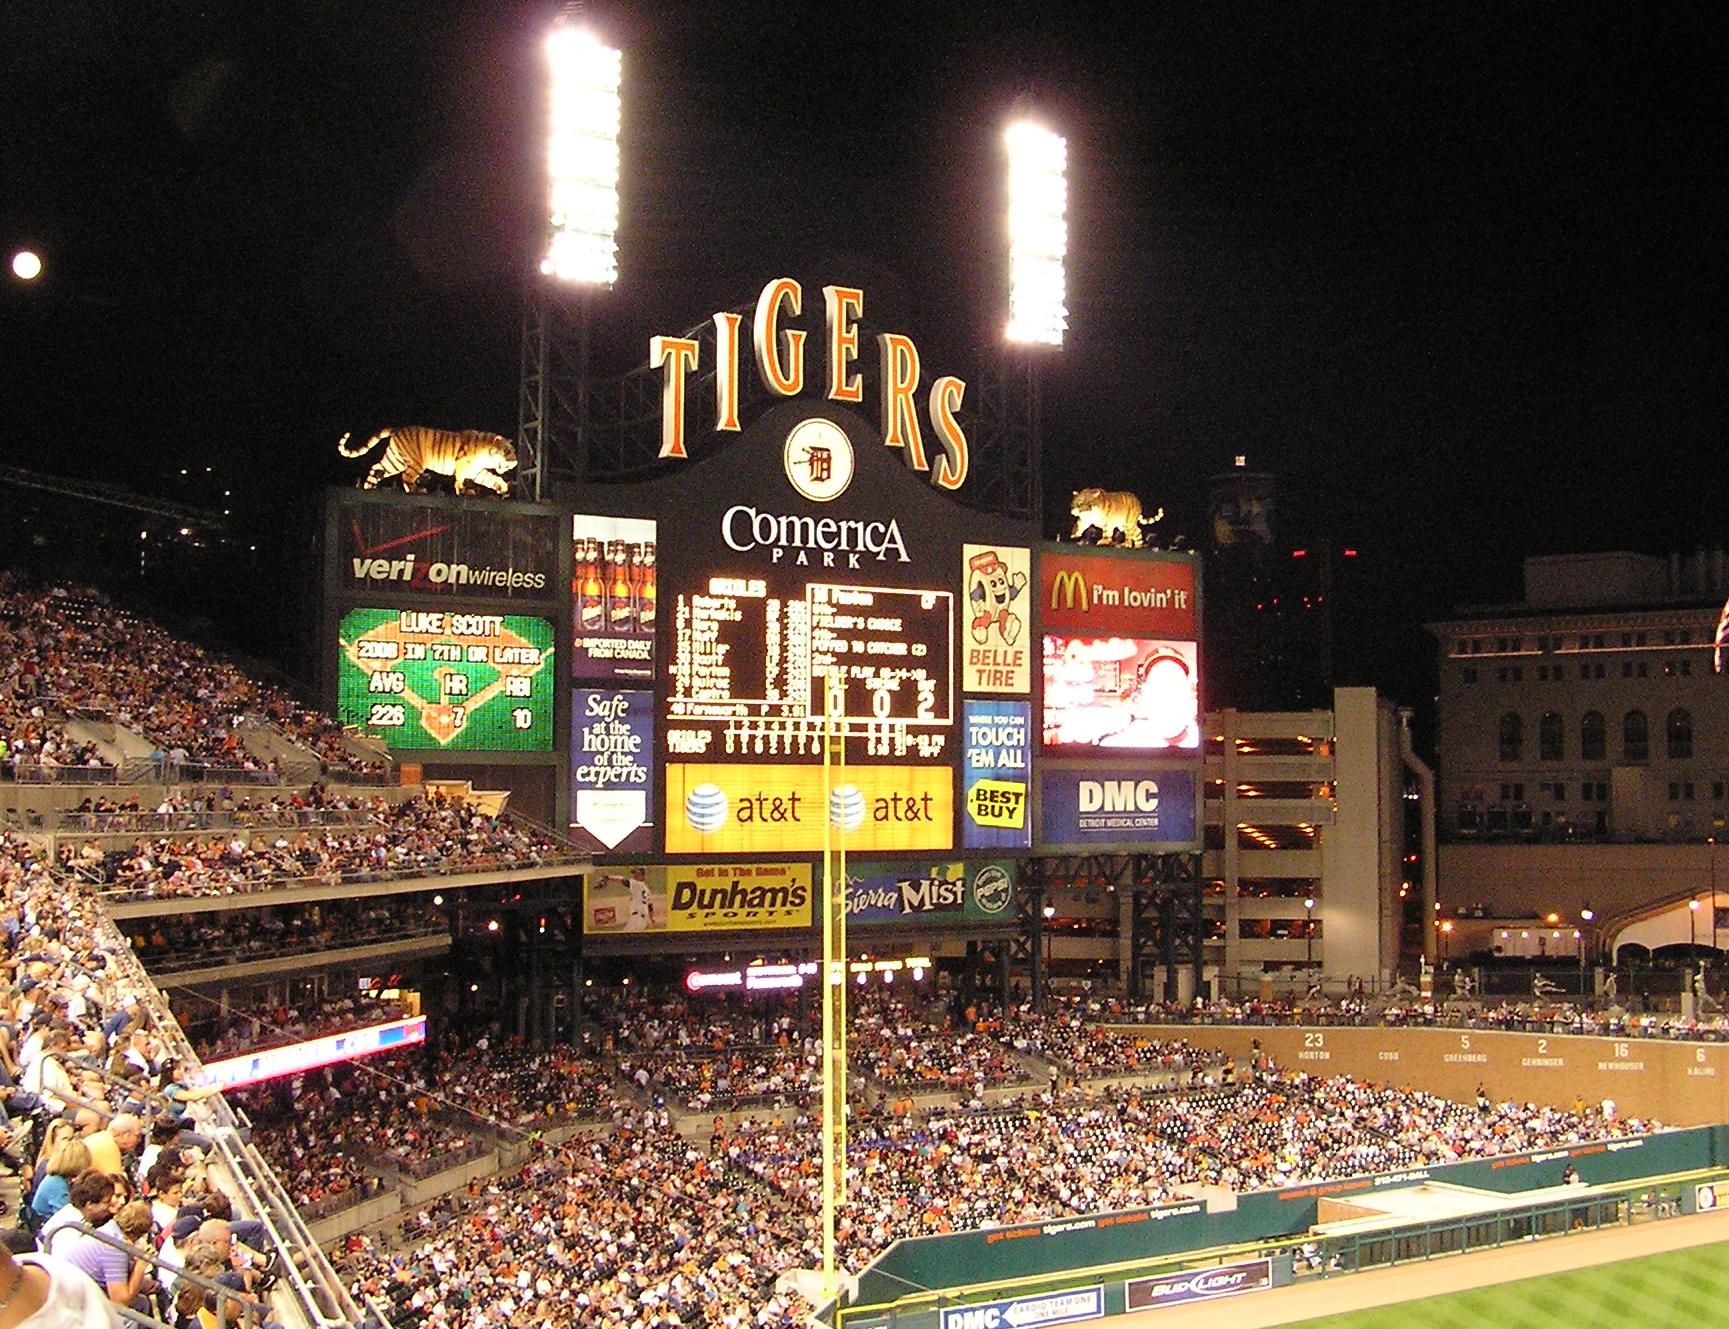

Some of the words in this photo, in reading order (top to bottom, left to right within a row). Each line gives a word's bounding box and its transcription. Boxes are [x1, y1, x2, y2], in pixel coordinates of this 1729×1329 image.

[650, 277, 970, 490] TIGERS
[772, 548, 861, 569] PARK
[353, 554, 468, 588] verizon
[469, 567, 546, 588] wireless
[1093, 584, 1119, 606] i'm
[1124, 586, 1171, 608] lovin'
[1174, 589, 1188, 609] it
[401, 612, 444, 634] LUKE
[450, 615, 504, 637] SCOTT
[404, 642, 426, 660] IN
[432, 643, 461, 661] 7TH
[467, 645, 488, 662] OR
[493, 646, 541, 664] LATER
[582, 637, 627, 649] IMPORTED
[627, 639, 652, 651] DAILY
[588, 648, 614, 658] FROM
[969, 649, 1023, 667] BELLE
[369, 671, 405, 693] AVG
[444, 673, 468, 695] HR
[505, 676, 531, 697] RBI
[976, 669, 1015, 687] TIRE
[585, 694, 629, 722] Safe
[873, 688, 891, 718] 0
[917, 690, 935, 719] 2
[368, 704, 405, 726] .226
[452, 706, 465, 728] 7
[512, 708, 532, 729] 10
[994, 716, 1008, 725] YOU
[1009, 716, 1024, 725] CAN
[592, 721, 608, 735] at
[609, 720, 631, 735] the
[969, 727, 1025, 747] TOUCH
[582, 728, 641, 752] home
[594, 751, 611, 766] of
[612, 751, 633, 766] the
[967, 749, 995, 768] 'EM
[997, 749, 1025, 768] ALL
[576, 762, 647, 788] experts
[873, 791, 933, 821] at&t
[976, 788, 1023, 805] BEST
[1079, 780, 1159, 812] DMC
[736, 791, 801, 822] at&t
[977, 803, 1017, 819] BUY
[1079, 819, 1105, 828] DETROIT
[696, 867, 715, 878] Get
[732, 867, 753, 877] The
[671, 878, 807, 911] Dunham's
[895, 879, 965, 915] Mist
[686, 910, 796, 919] SPORTS
[1304, 1032, 1324, 1048] 23
[1461, 1035, 1470, 1049] 5
[1537, 1039, 1547, 1054] 2
[1614, 1042, 1629, 1058] 16
[1444, 1053, 1488, 1063] GREENBERG
[1695, 1047, 1706, 1063] 6
[1042, 1219, 1096, 1236] tigers.com
[1150, 1204, 1201, 1220] tigers.com
[1151, 1281, 1191, 1298] BUD
[1197, 1272, 1247, 1290] LIGHT
[1013, 1301, 1048, 1314] CARDIO
[1049, 1298, 1073, 1309] TEAM
[1074, 1295, 1092, 1305] ONE
[948, 1307, 1001, 1329] DMC
